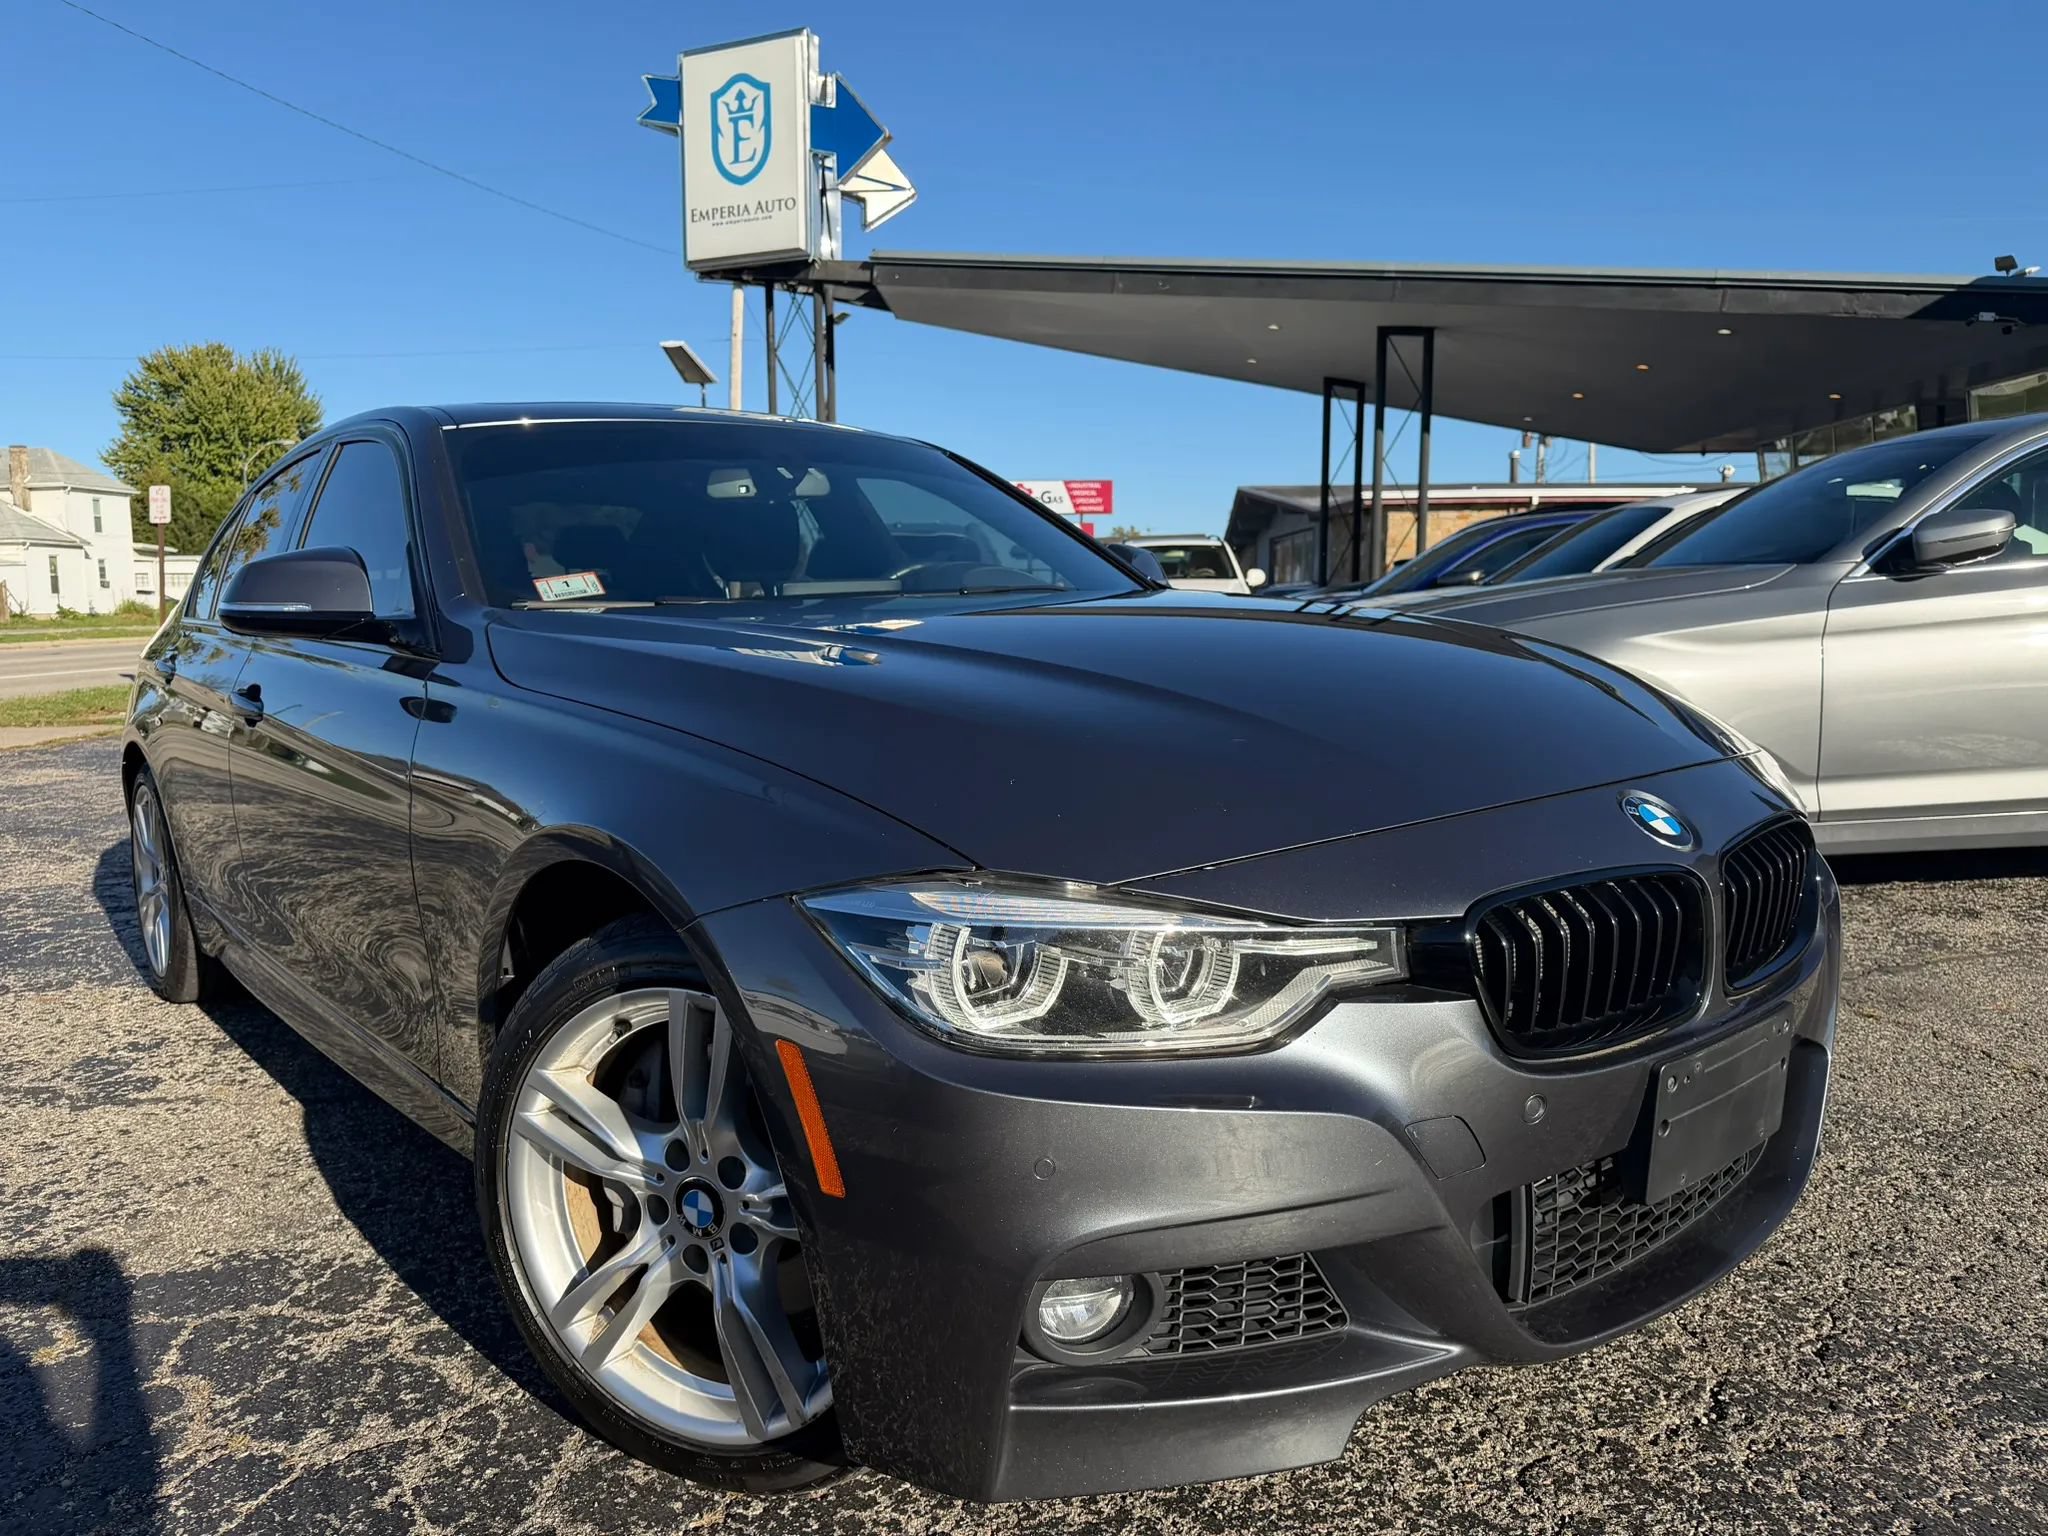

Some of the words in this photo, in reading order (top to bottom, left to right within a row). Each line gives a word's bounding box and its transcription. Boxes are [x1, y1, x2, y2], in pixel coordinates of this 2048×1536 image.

[728, 114, 757, 165] E
[691, 203, 751, 223] EMPERIA
[754, 196, 796, 215] AUTO
